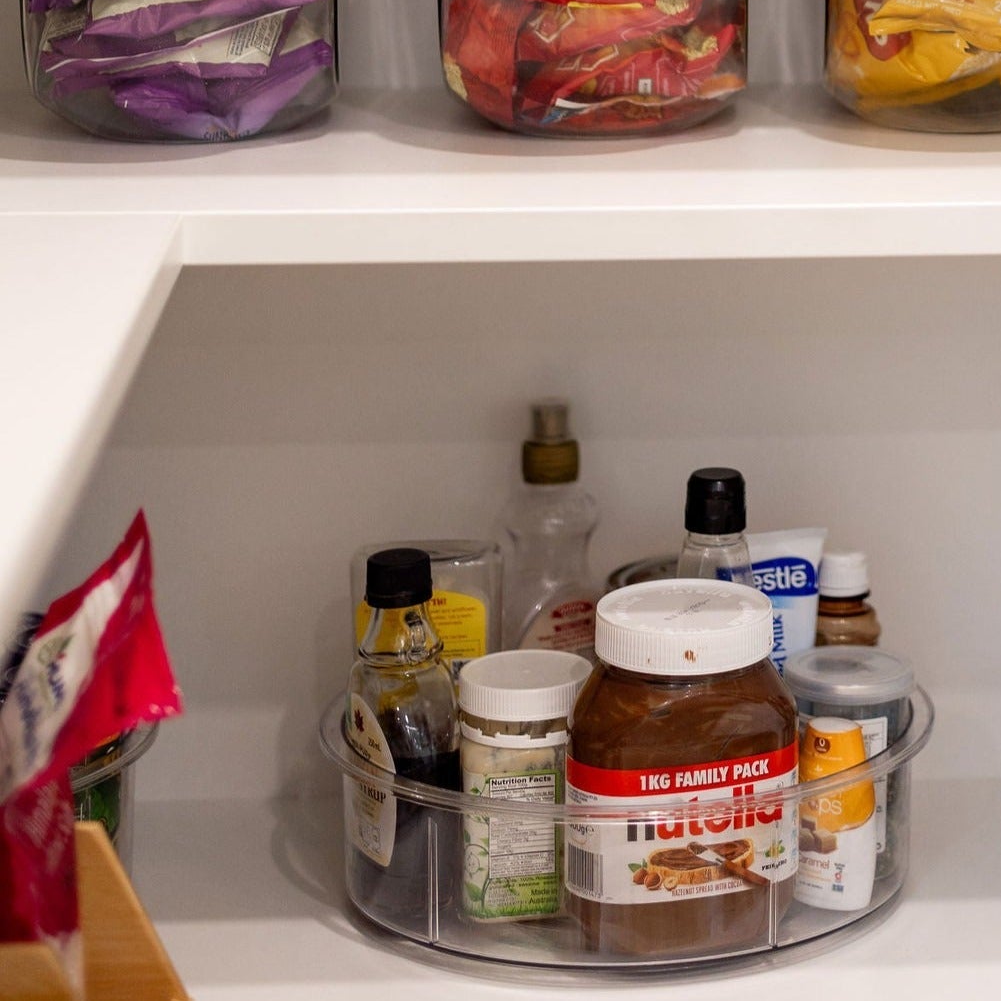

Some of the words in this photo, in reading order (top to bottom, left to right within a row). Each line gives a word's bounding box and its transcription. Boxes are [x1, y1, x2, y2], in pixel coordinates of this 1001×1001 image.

[492, 777, 527, 786] Nutrition
[529, 775, 552, 783] Facts
[640, 775, 671, 791] 1KG
[675, 765, 728, 788] FAMILY
[733, 759, 769, 781] PACK
[627, 785, 784, 841] nutella
[696, 885, 714, 895] SPREAD
